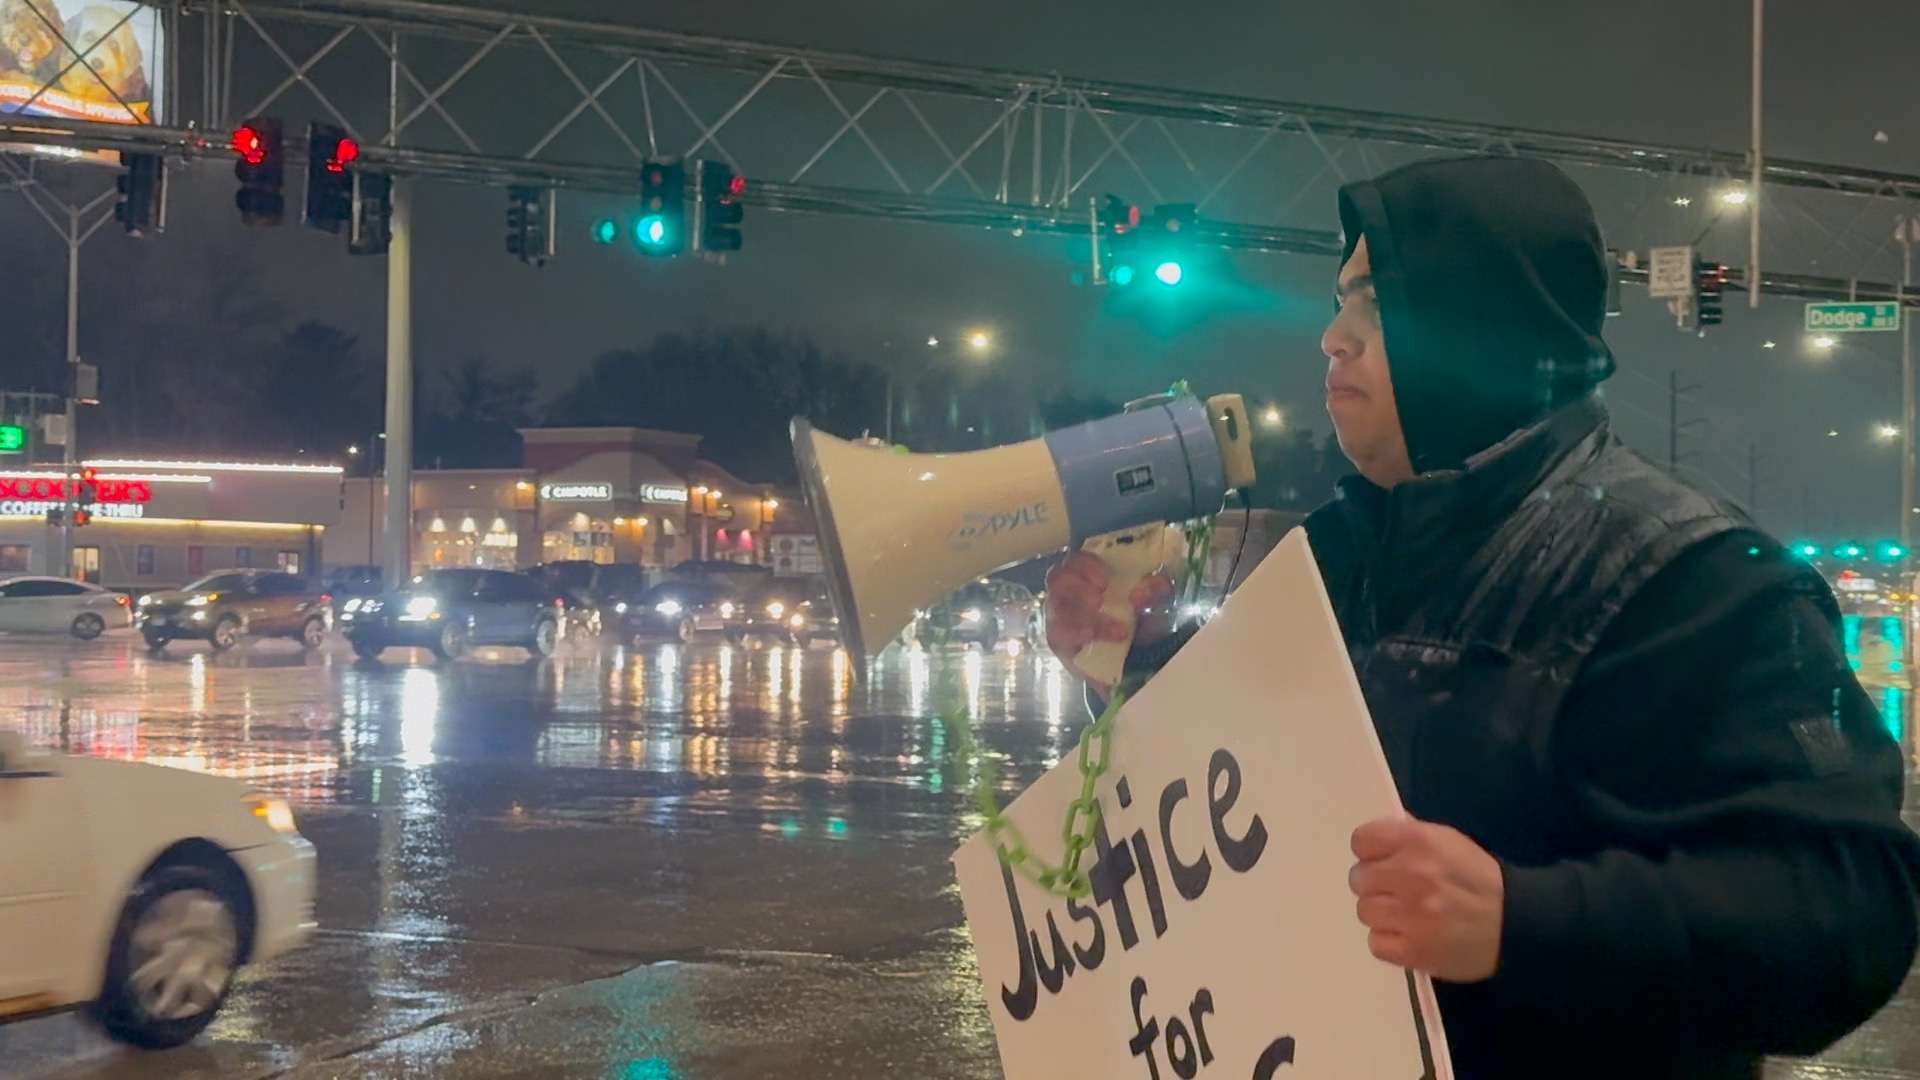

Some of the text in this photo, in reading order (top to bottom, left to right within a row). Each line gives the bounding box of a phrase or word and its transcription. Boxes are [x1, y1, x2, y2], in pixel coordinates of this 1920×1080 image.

[1811, 308, 1866, 328] Dodge
[987, 502, 1048, 535] PYLE
[1001, 748, 1268, 1022] Justice
[1129, 976, 1214, 1080] for
